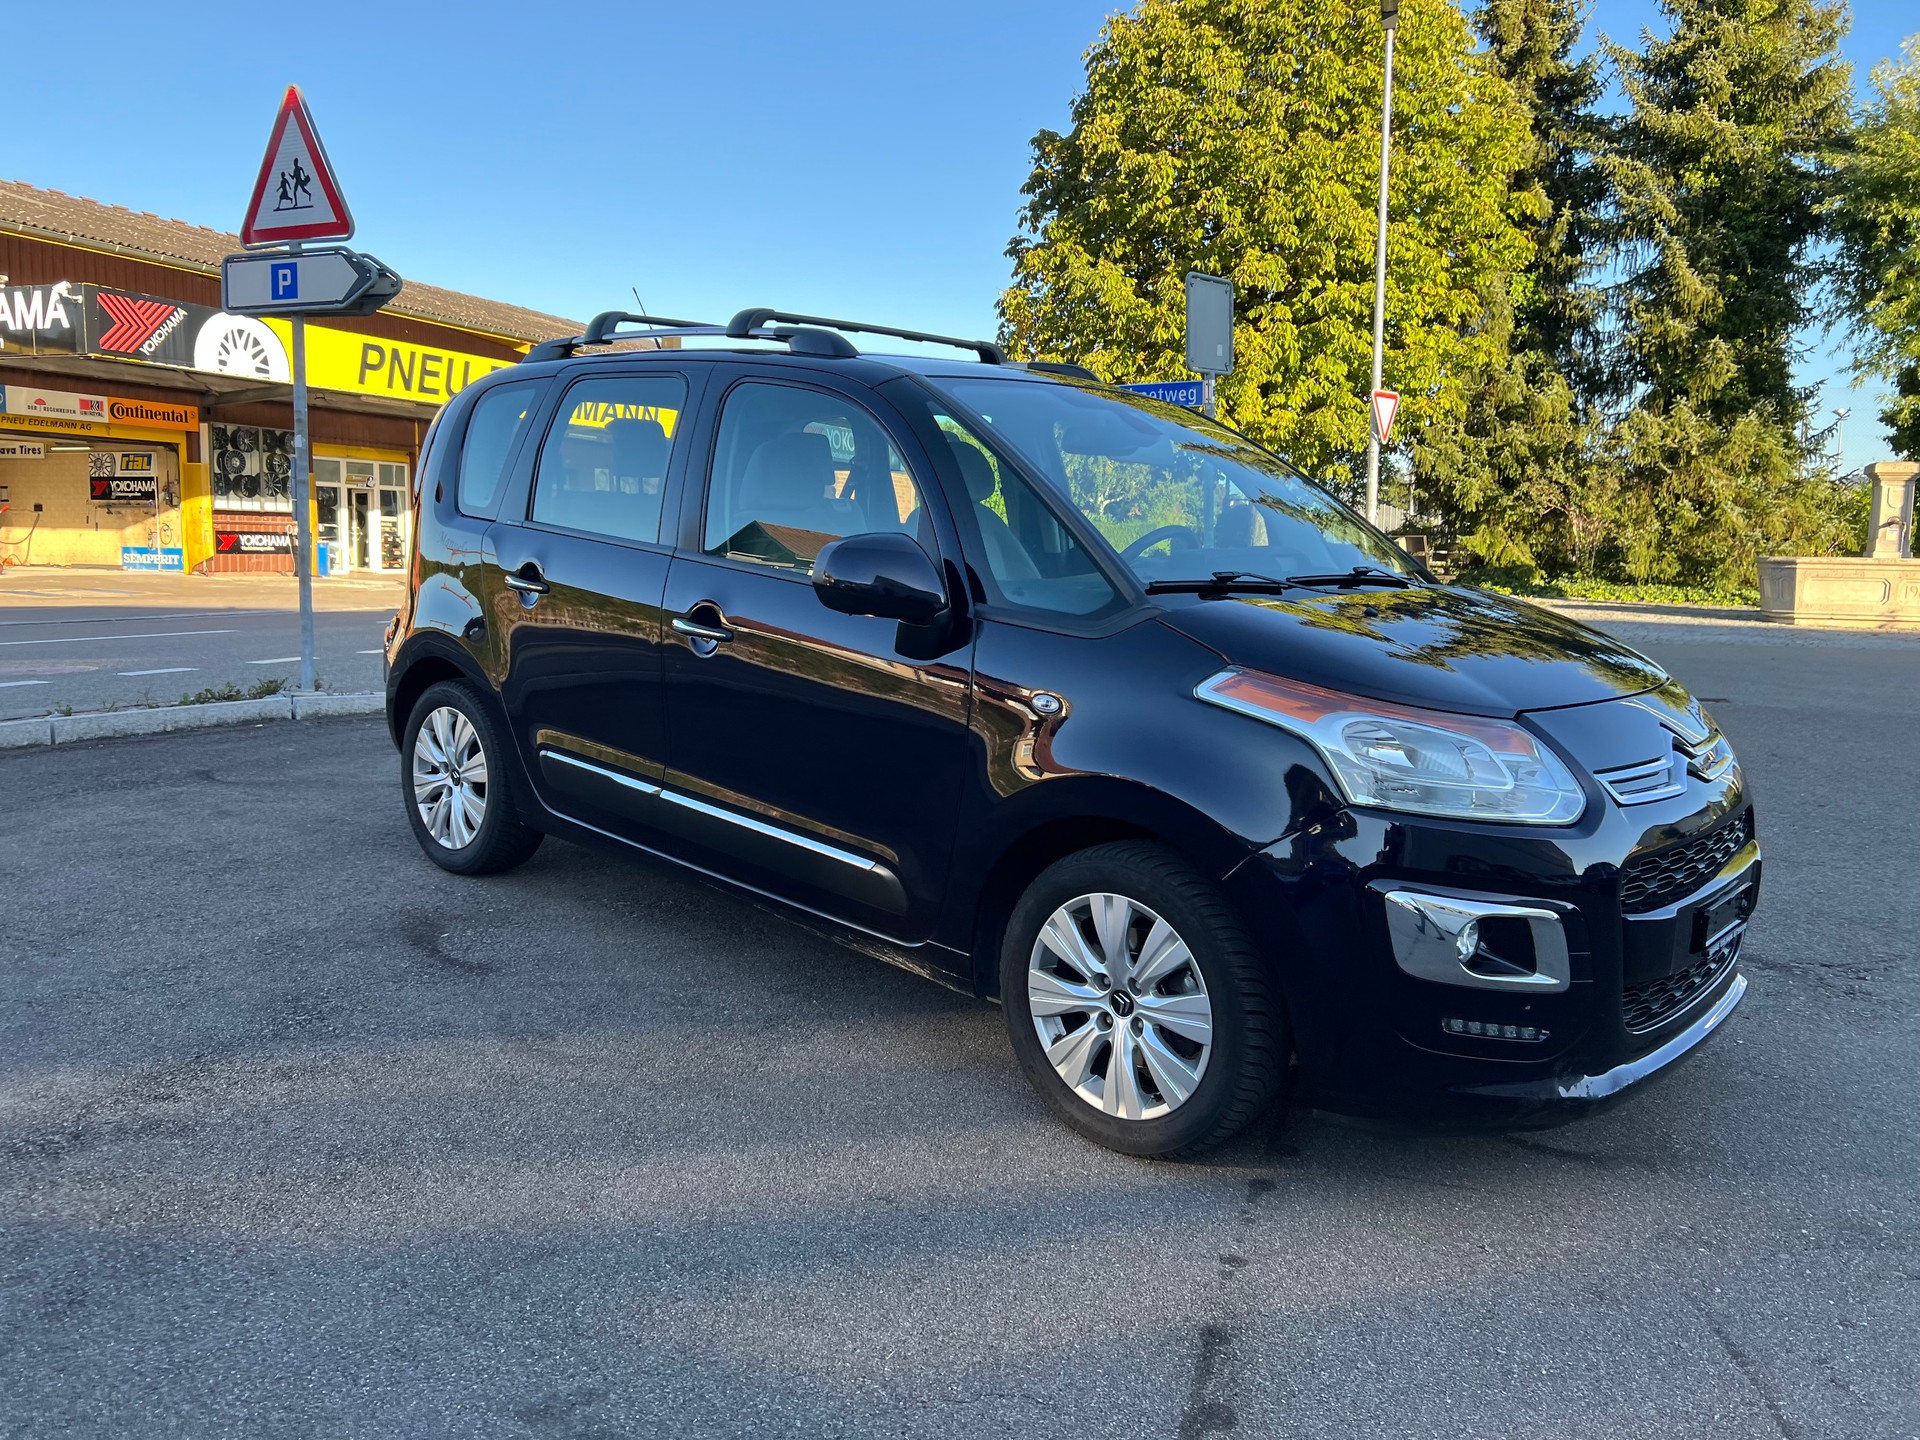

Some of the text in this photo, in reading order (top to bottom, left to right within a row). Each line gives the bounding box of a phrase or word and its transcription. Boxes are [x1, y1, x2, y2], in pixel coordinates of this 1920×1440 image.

[278, 268, 292, 296] P
[139, 307, 188, 356] YOKOHAMA
[358, 342, 471, 397] PNEU
[109, 402, 189, 424] Continental
[1, 416, 92, 431] PNEU EDELMANN AG
[19, 445, 42, 455] Tires
[110, 480, 156, 492] YOKOHAMA
[238, 534, 290, 547] YOKOHAMA
[123, 553, 180, 565] SEMPERIT
